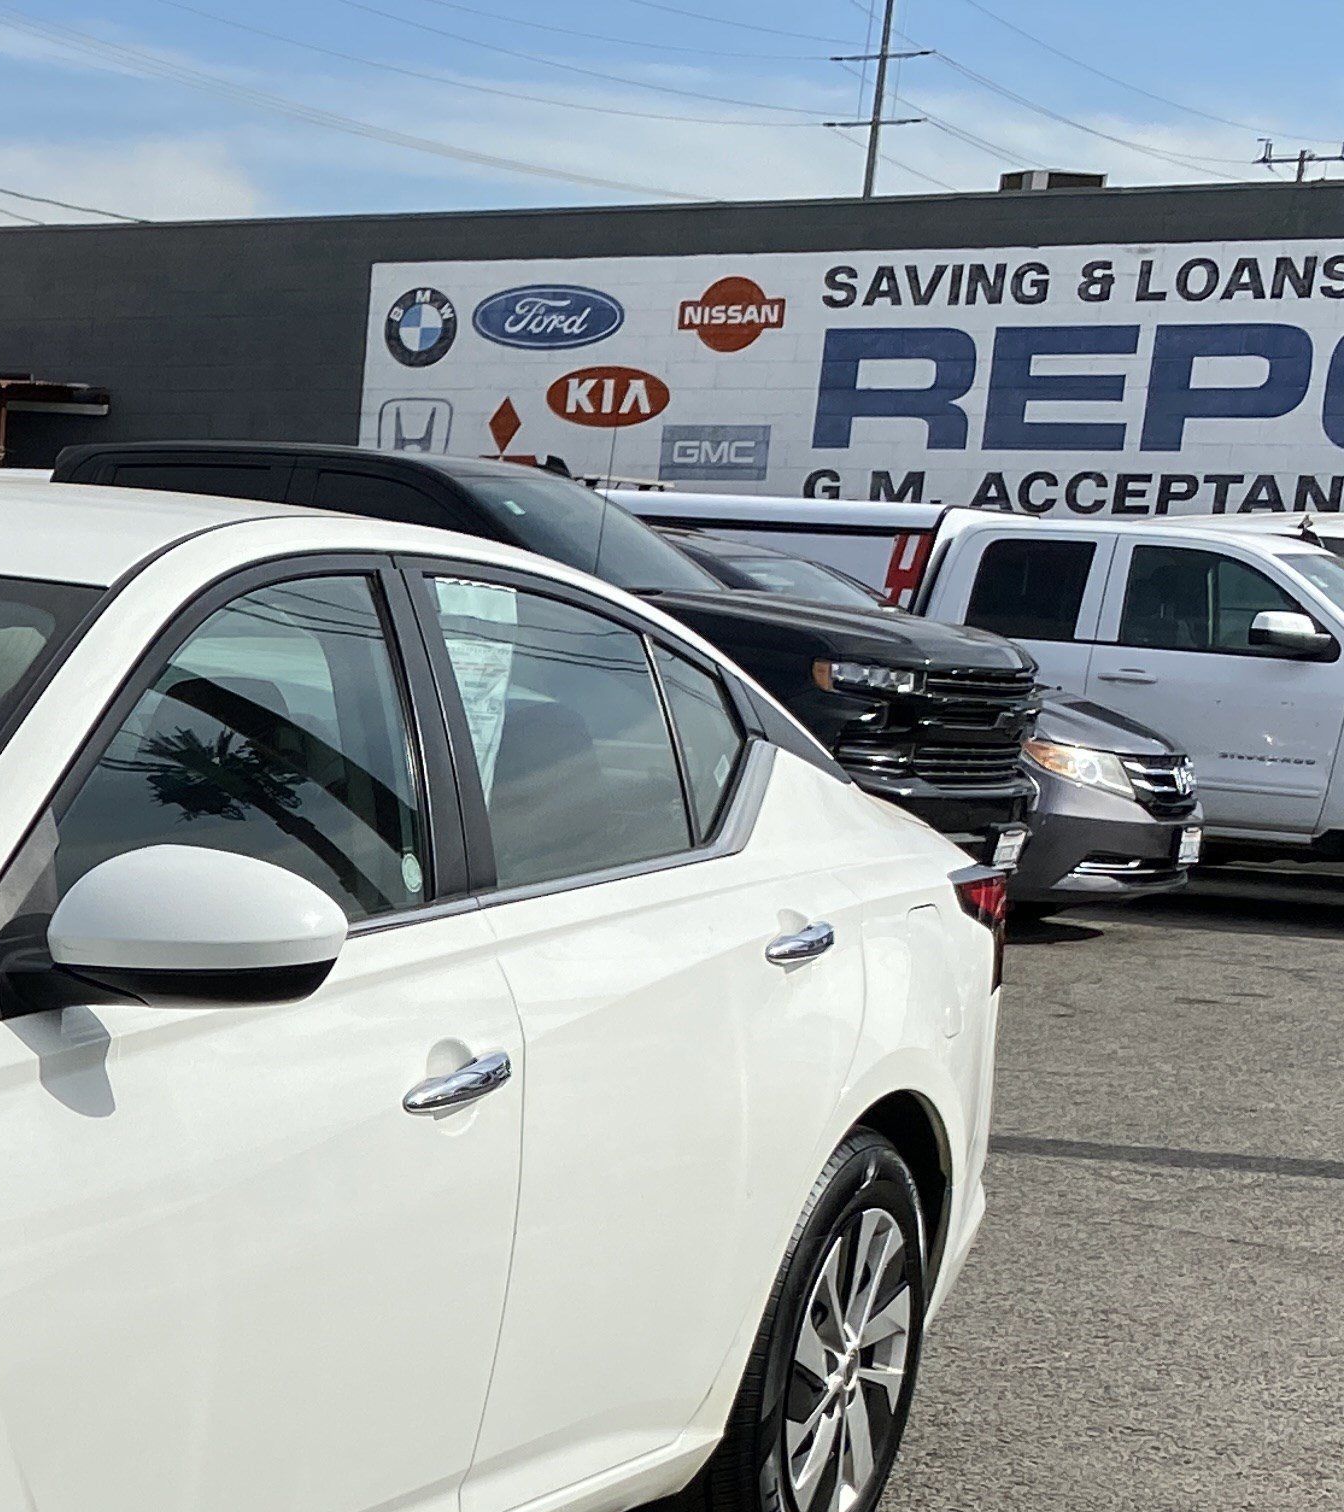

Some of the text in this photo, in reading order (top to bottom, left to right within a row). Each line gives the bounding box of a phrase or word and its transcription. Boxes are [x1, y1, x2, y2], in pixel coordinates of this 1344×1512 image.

[822, 255, 1344, 309] SAVING & LOANS
[504, 297, 591, 336] Ford
[683, 304, 779, 326] NISSAN
[565, 378, 651, 415] KIA
[812, 323, 1344, 452] REP
[672, 440, 755, 465] GMC
[969, 471, 1344, 515] ACCEPTAN
